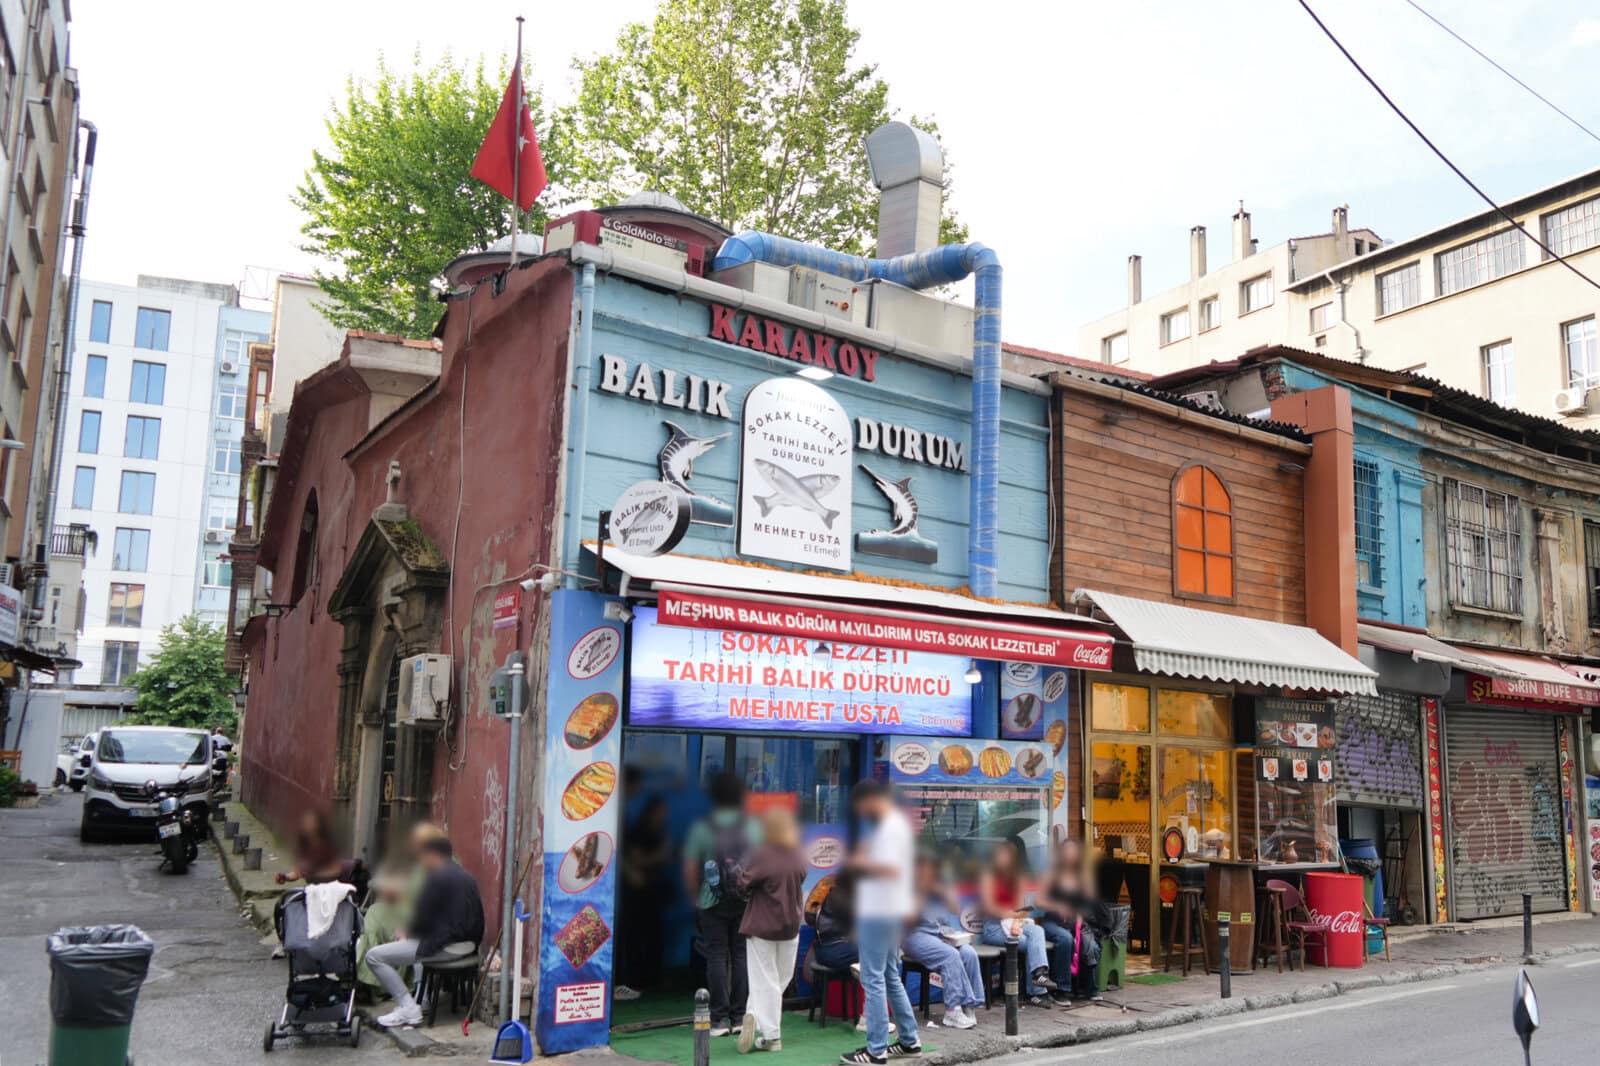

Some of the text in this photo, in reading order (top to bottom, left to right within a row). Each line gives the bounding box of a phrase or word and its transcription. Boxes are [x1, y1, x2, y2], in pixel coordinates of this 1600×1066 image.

[612, 220, 663, 244] GoldMoto
[598, 353, 733, 419] BALIK
[748, 411, 792, 435] SOKAK
[803, 441, 835, 456] BALIK
[614, 503, 641, 527] BALIK
[753, 522, 841, 546] MEHMET USTA
[665, 599, 1056, 657] MEŞHUR BALIK DÜRÜM M.YILDIRIM USTA SOKAK LEZZETLERİ
[721, 632, 809, 657] SOKAK
[663, 659, 951, 697] TARİHİ BALIK DÜRÜMCÜ
[728, 697, 901, 725] MEHMET USTA
